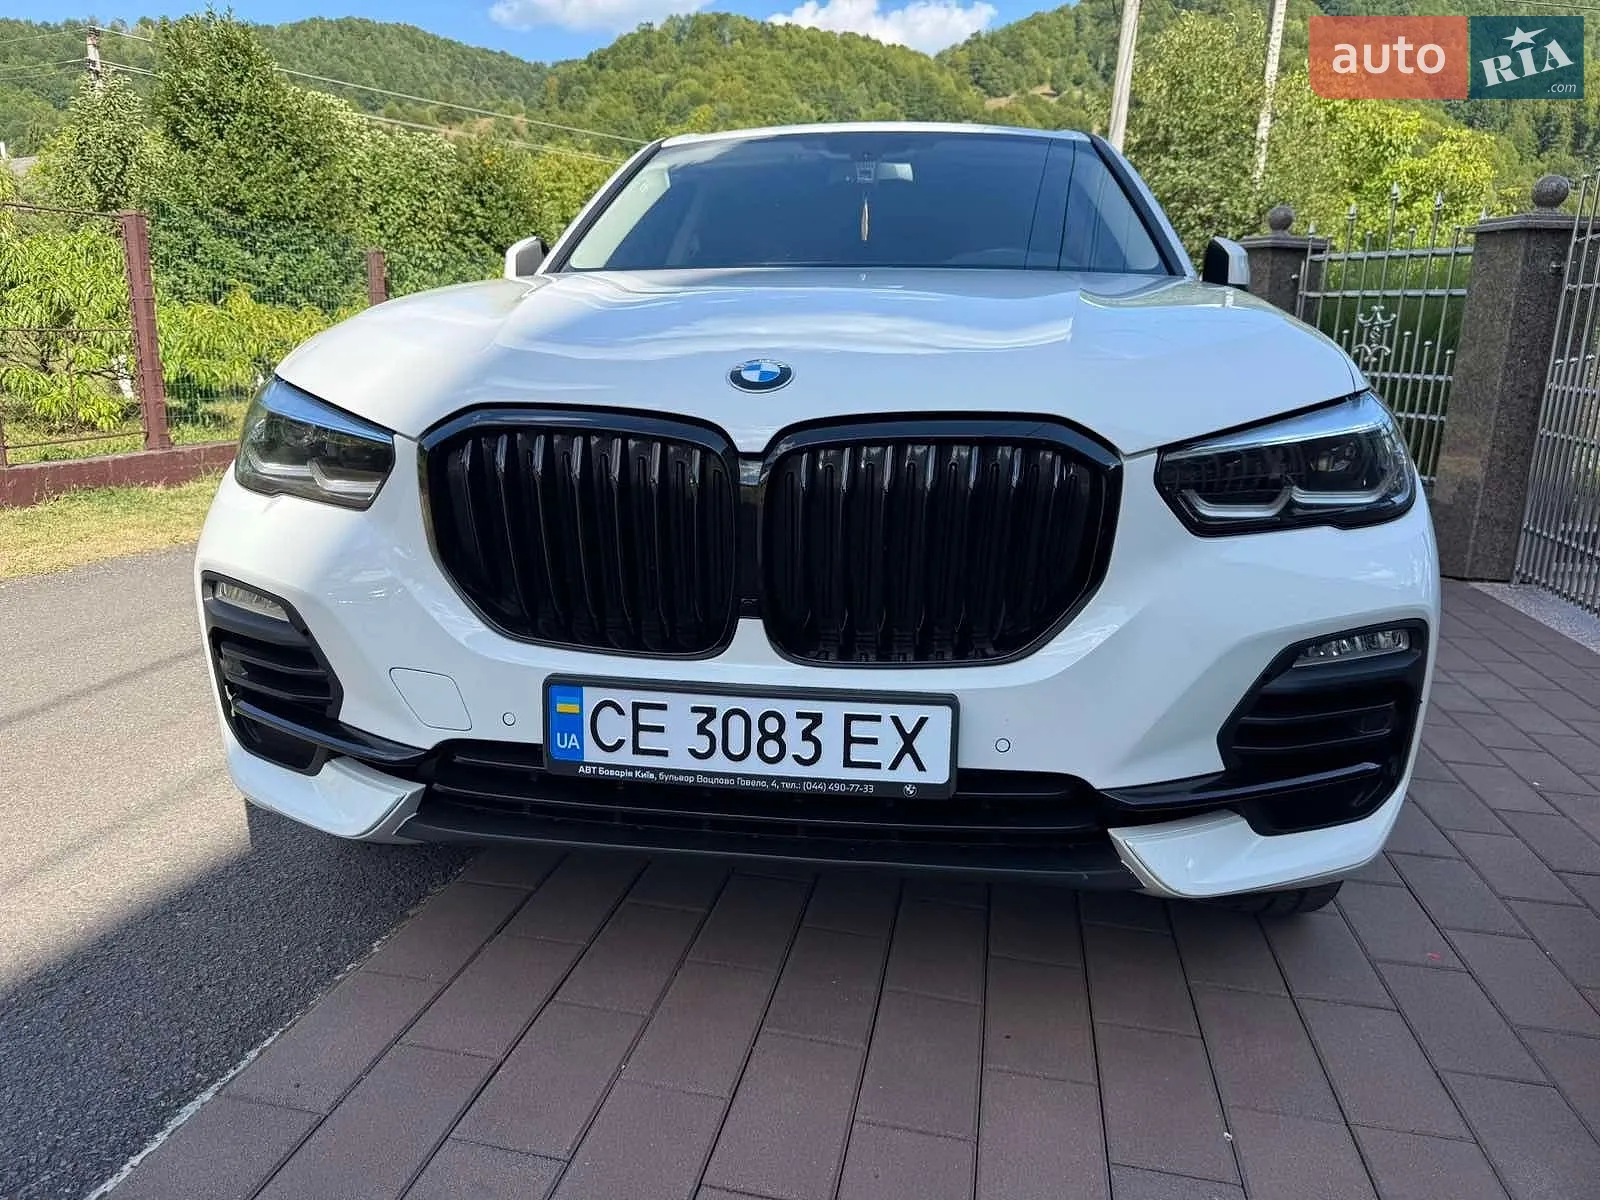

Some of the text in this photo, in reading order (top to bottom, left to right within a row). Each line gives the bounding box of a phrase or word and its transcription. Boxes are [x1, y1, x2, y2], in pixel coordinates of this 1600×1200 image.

[556, 731, 580, 750] UA
[590, 699, 929, 772] CE 3083 EX
[803, 781, 826, 792] (044)
[828, 783, 874, 793] 490-77-33
